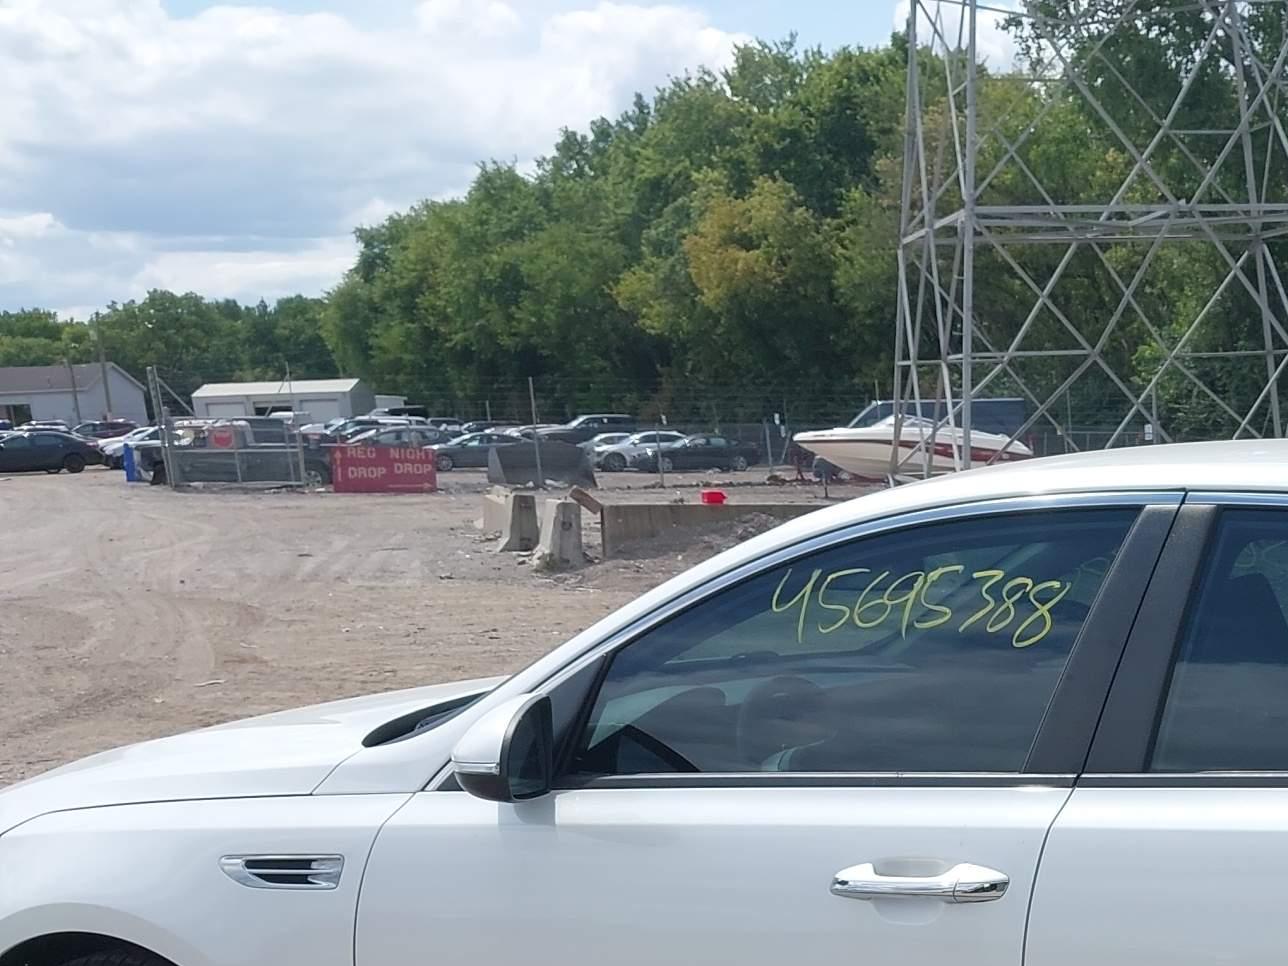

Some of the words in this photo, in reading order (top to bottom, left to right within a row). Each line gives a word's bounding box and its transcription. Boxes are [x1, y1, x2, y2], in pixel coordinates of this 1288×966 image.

[390, 447, 433, 460] NIGHT
[348, 466, 386, 479] DROP
[394, 463, 432, 475] DROP
[771, 564, 1072, 648] 45695388
